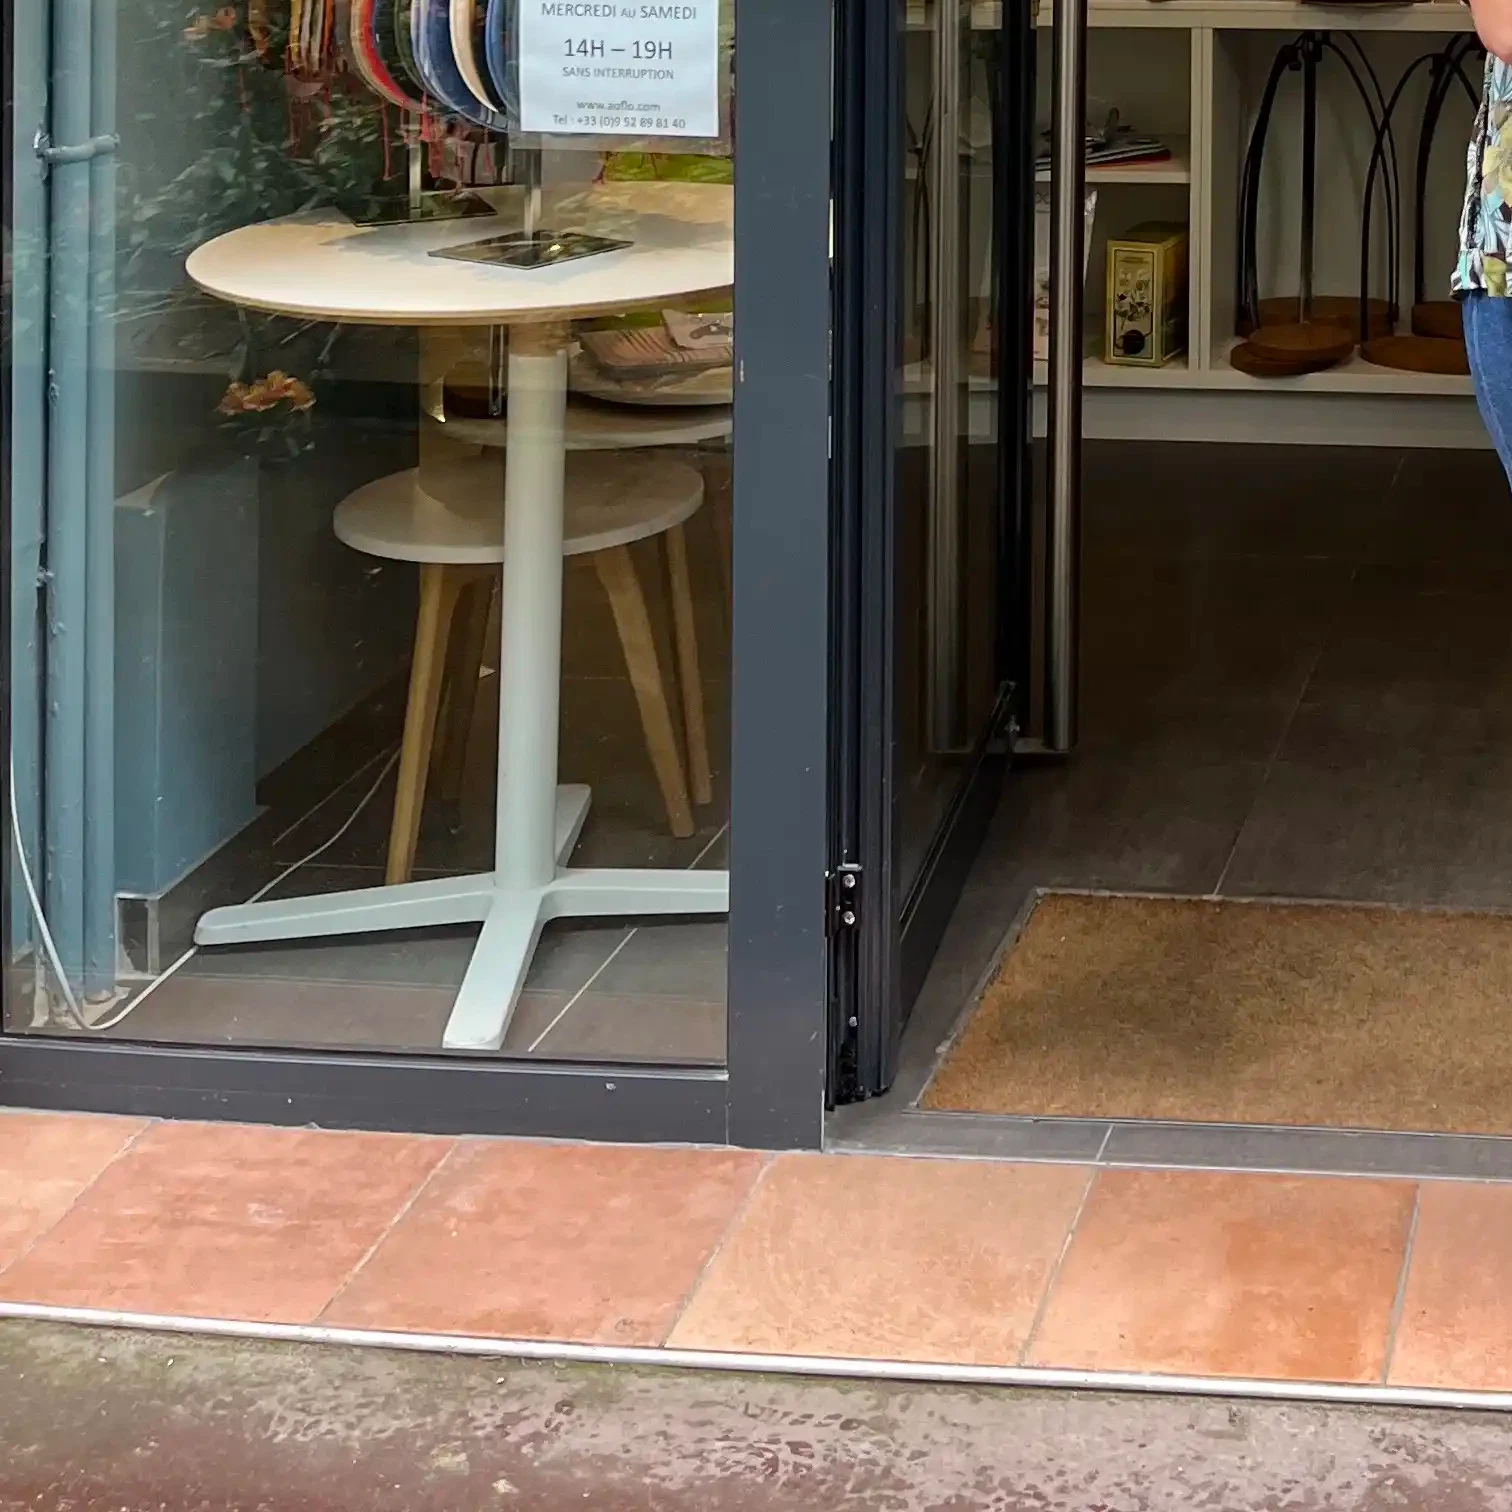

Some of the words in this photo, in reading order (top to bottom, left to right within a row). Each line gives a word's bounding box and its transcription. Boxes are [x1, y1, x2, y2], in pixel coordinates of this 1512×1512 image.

[541, 3, 616, 17] MERCREDI
[620, 8, 636, 18] AU
[640, 5, 697, 19] SAMEDI
[564, 38, 604, 58] 14H
[632, 40, 672, 60] 19H
[562, 66, 591, 78] SANS
[593, 67, 674, 80] INTERRUPTION
[577, 115, 597, 126] +33
[599, 116, 621, 127] (0)9
[624, 116, 637, 127] 52
[640, 117, 654, 128] 89
[656, 118, 669, 129] 81
[672, 118, 686, 129] 40
